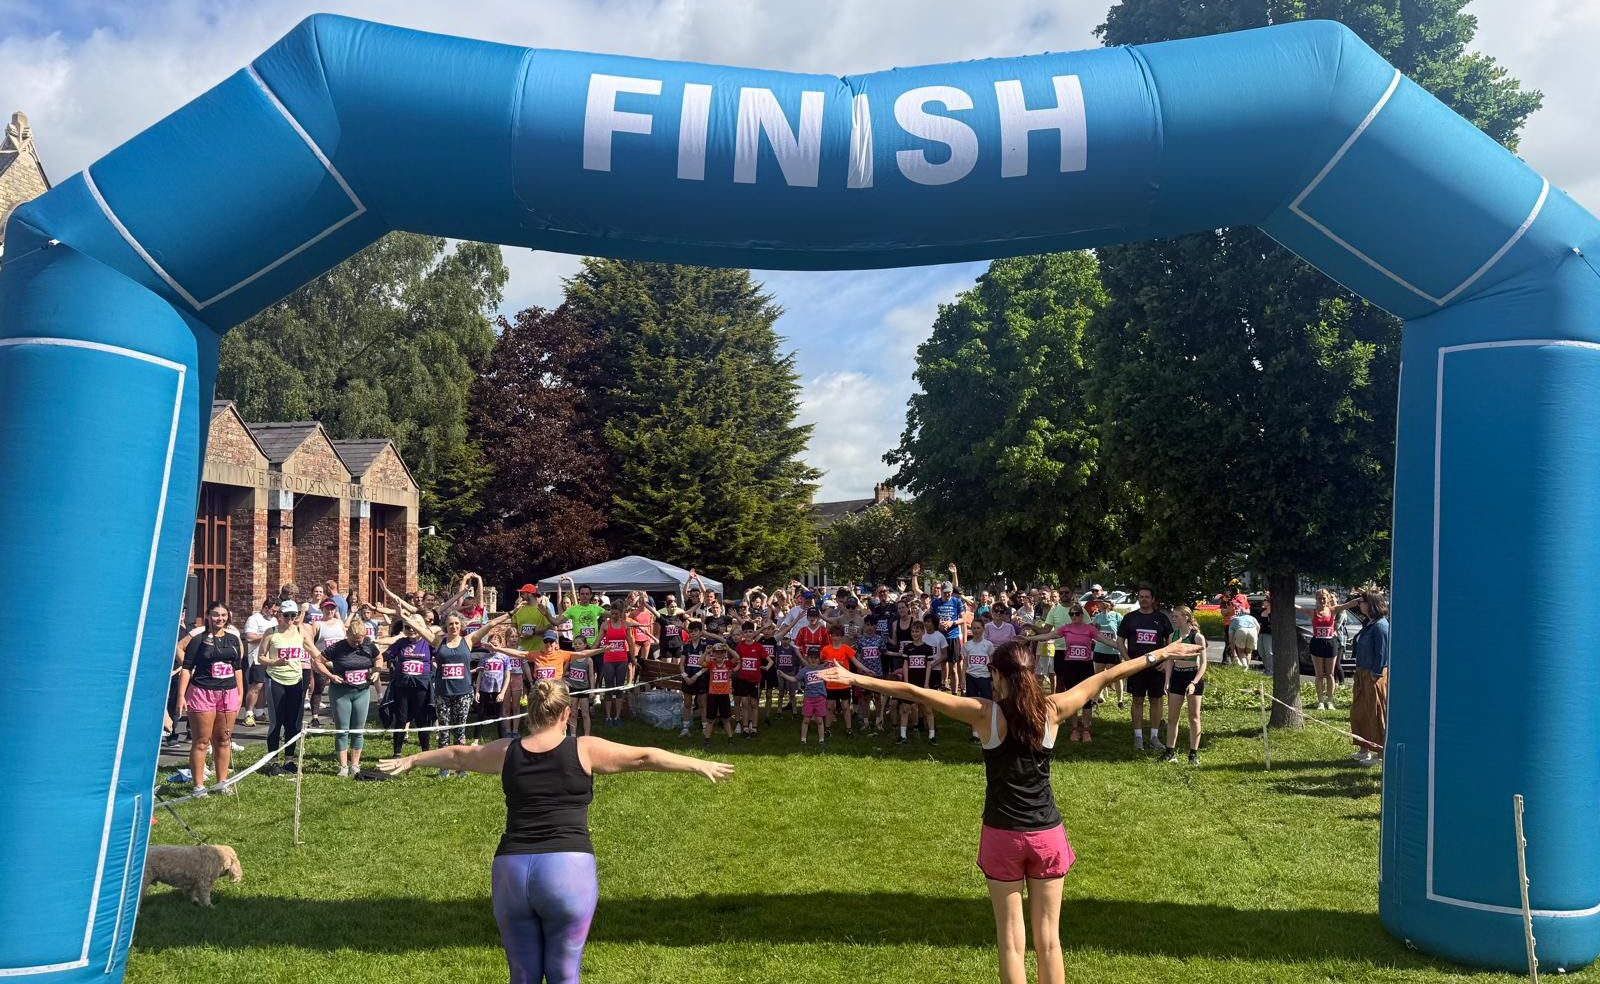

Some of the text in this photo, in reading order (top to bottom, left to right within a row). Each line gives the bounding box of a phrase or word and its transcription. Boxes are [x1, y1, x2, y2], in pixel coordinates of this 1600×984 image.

[583, 73, 1088, 189] FINISH
[246, 469, 378, 500] METHODIST CHURCH
[1137, 632, 1156, 642] 567
[863, 649, 878, 657] 570
[1070, 648, 1086, 656] 508
[742, 660, 756, 668] 621
[909, 658, 925, 667] 596
[970, 656, 986, 665] 592
[214, 663, 234, 676] 573
[403, 661, 421, 672] 501
[443, 666, 462, 677] 548
[485, 662, 500, 671] 517
[347, 672, 366, 683] 652
[537, 670, 554, 680] 597
[570, 670, 584, 679] 520
[713, 672, 728, 681] 614
[807, 672, 821, 682] 62
